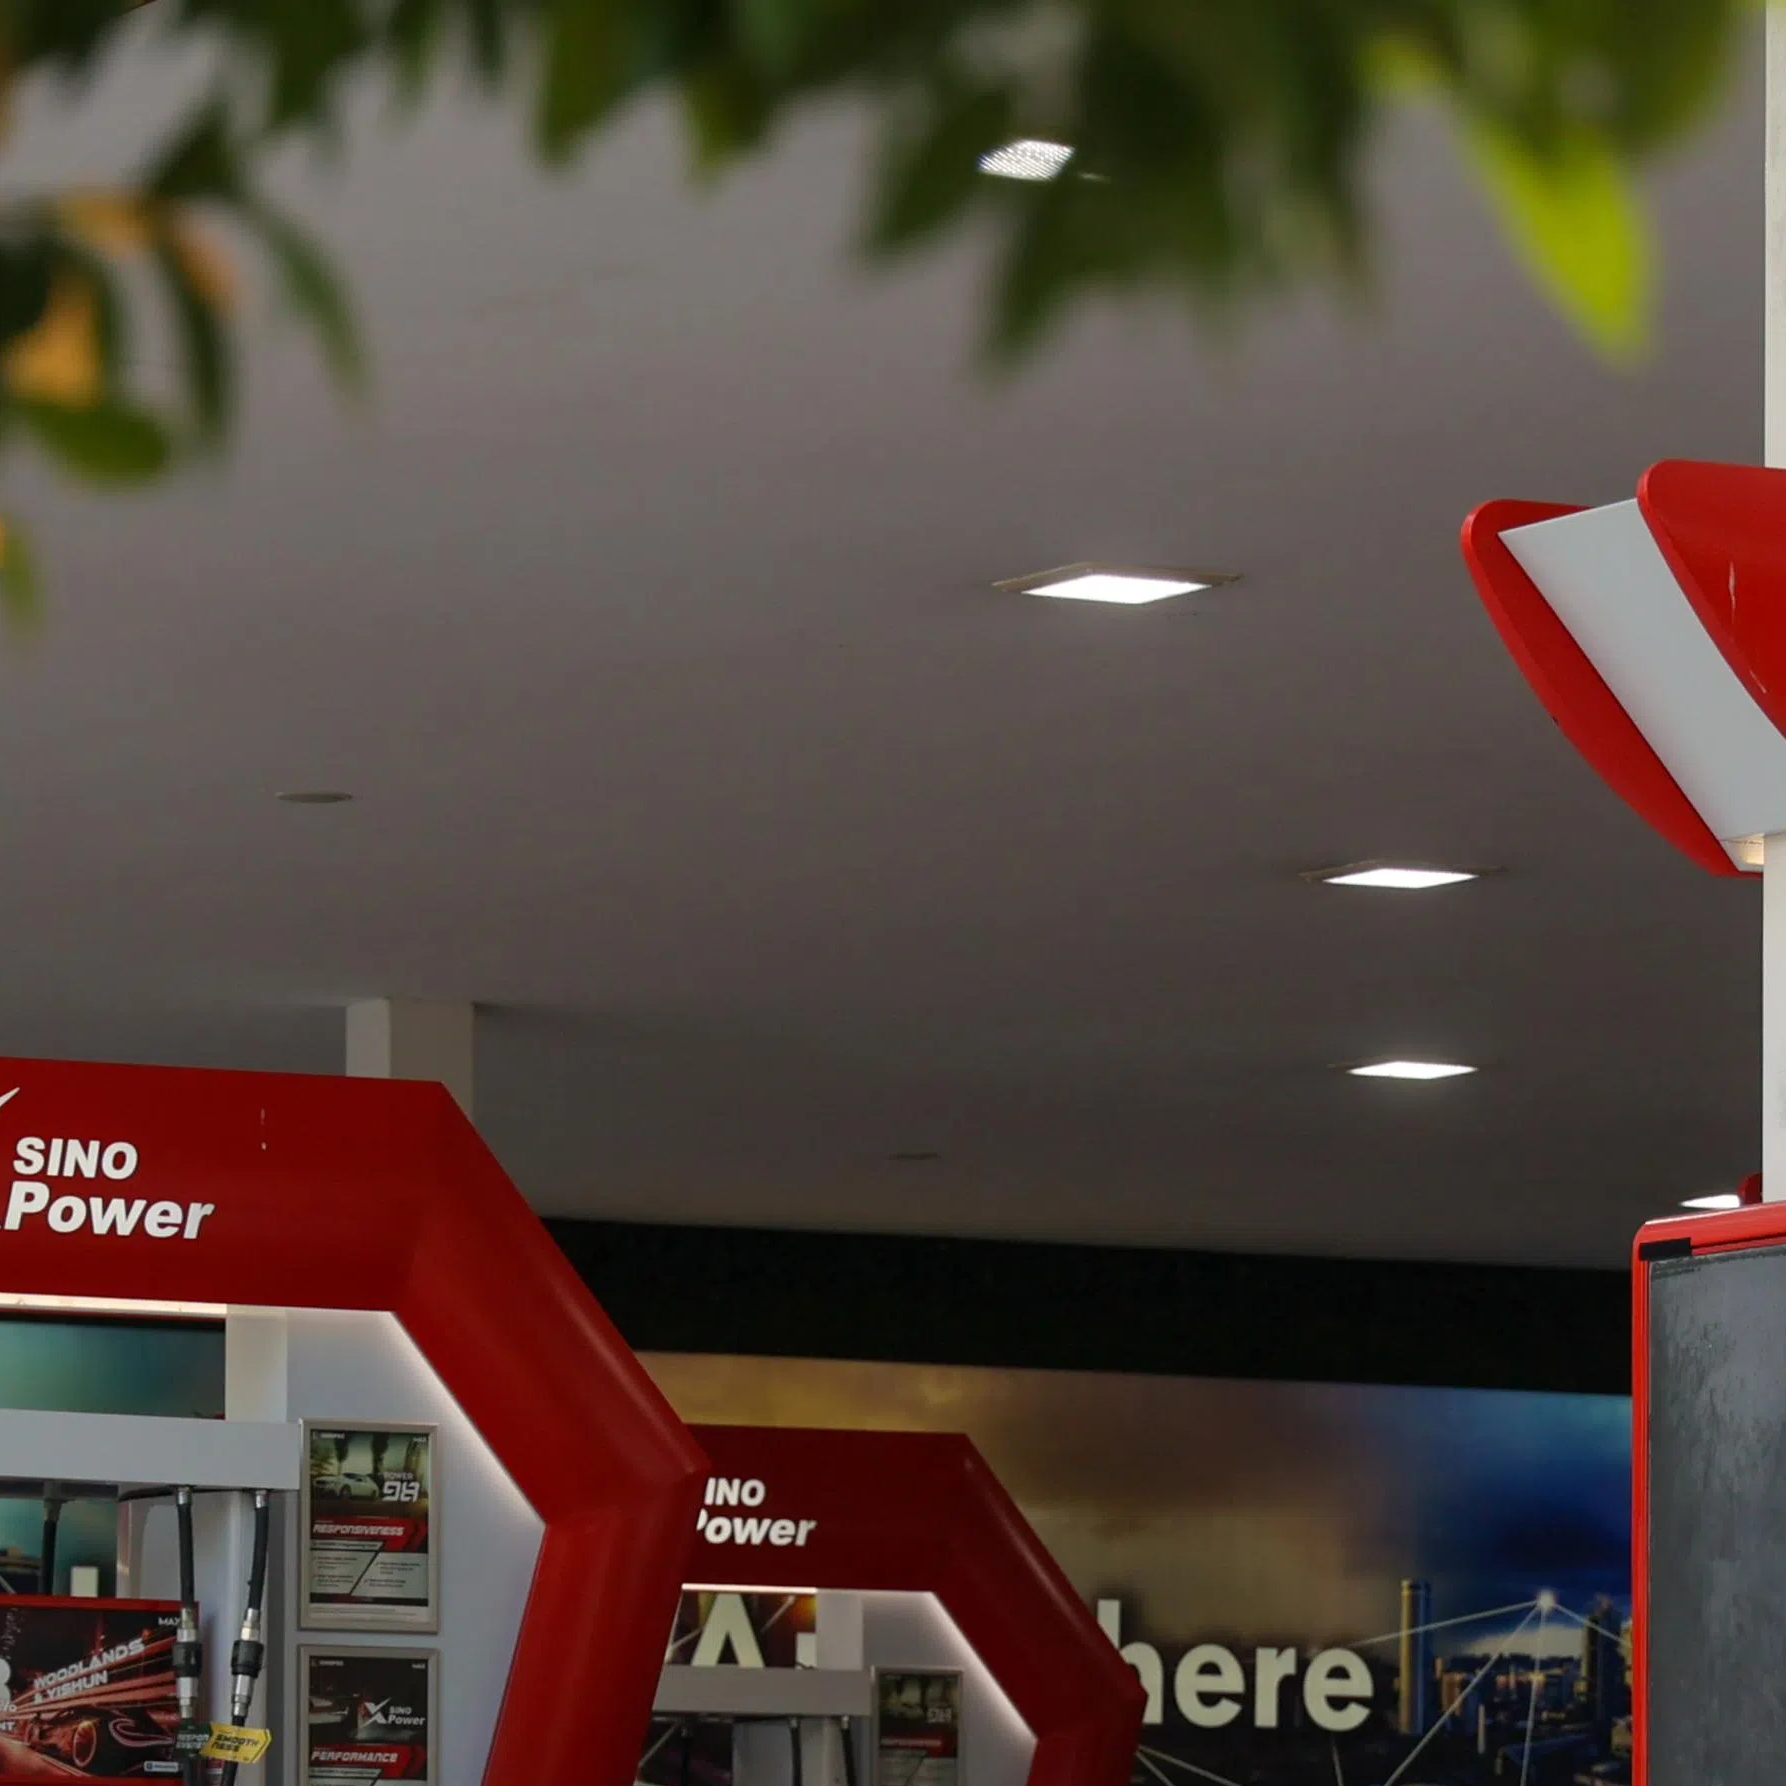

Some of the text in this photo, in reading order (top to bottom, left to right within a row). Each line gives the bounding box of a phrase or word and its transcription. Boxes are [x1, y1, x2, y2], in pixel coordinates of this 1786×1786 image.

[13, 1136, 139, 1181] SINO
[4, 1182, 215, 1240] Power
[382, 1481, 421, 1502] 98
[704, 1477, 766, 1507] INO
[33, 1638, 145, 1689] WOODLANDS
[47, 1670, 108, 1702] YISHUN
[388, 1714, 426, 1726] Power
[311, 1751, 398, 1763] PERFORMANCE
